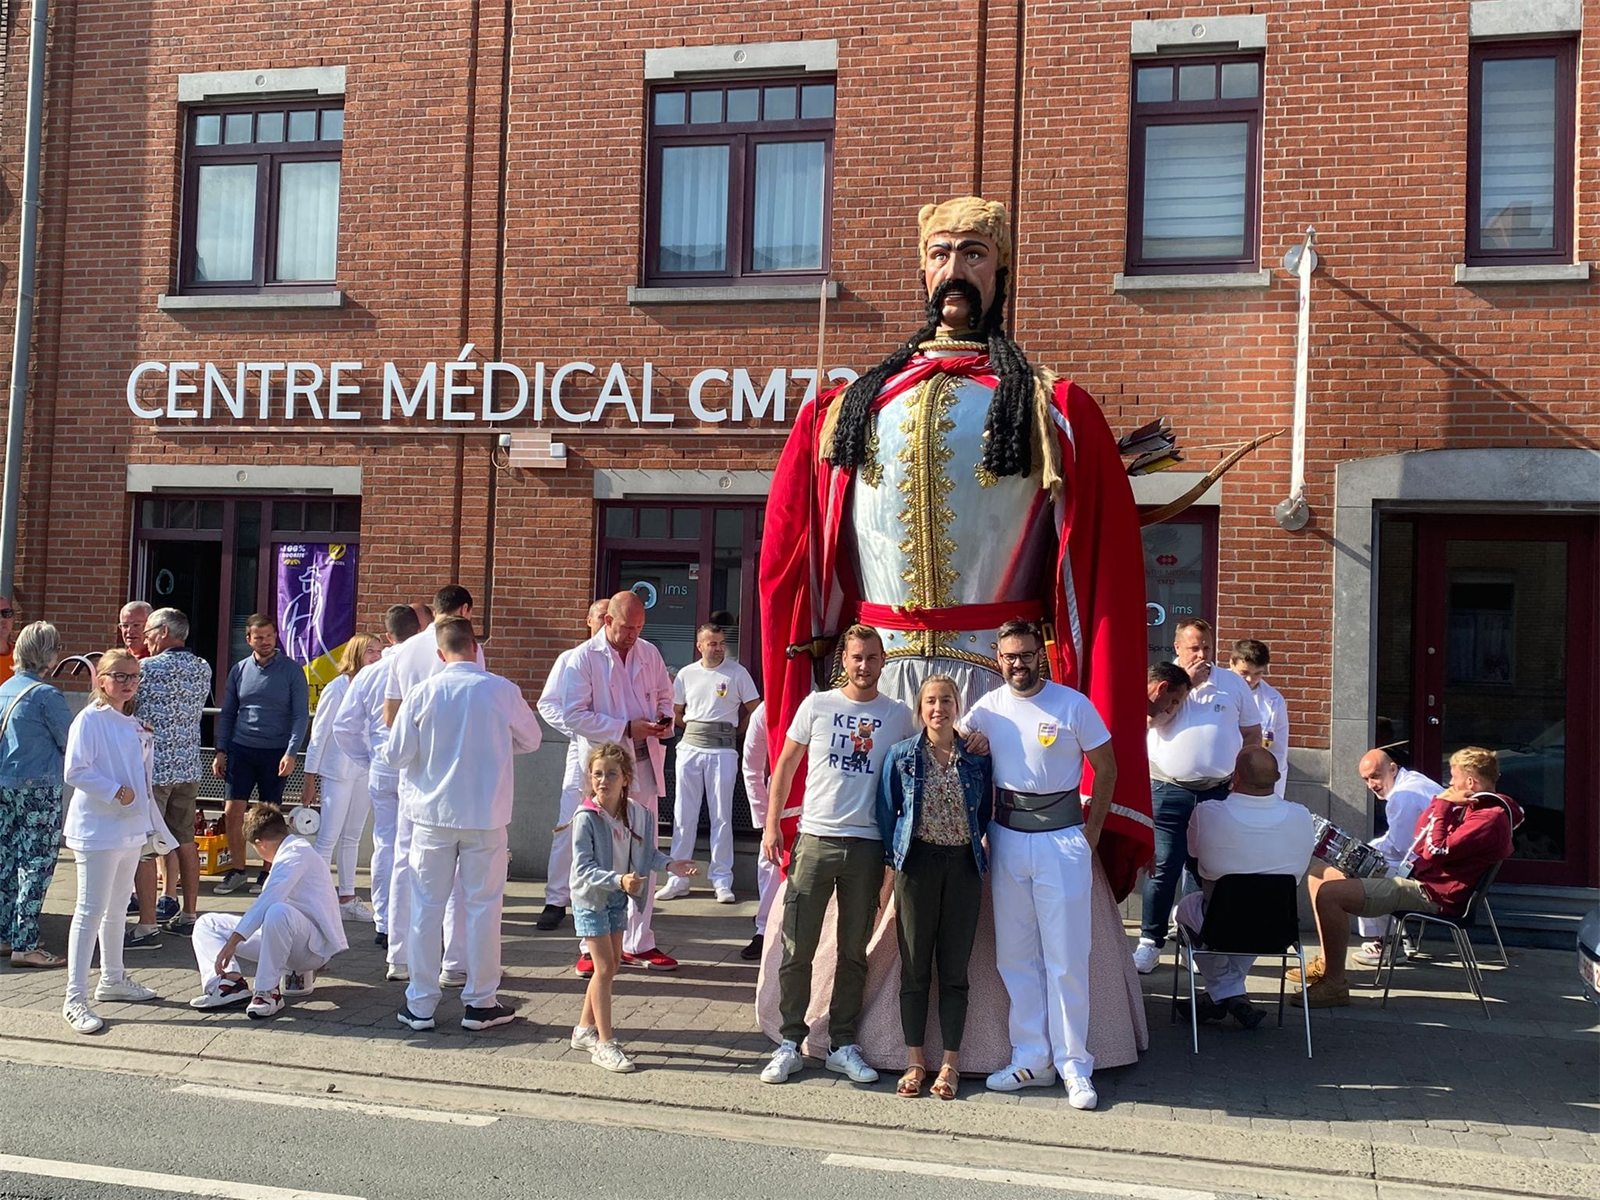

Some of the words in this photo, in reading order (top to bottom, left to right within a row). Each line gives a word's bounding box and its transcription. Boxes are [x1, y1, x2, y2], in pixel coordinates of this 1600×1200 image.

[127, 361, 363, 420] CENTRE
[382, 343, 675, 423] MÉDICAL
[664, 584, 688, 596] ims
[833, 712, 882, 730] KEEP
[831, 732, 849, 749] IT
[828, 753, 875, 775] REAL
